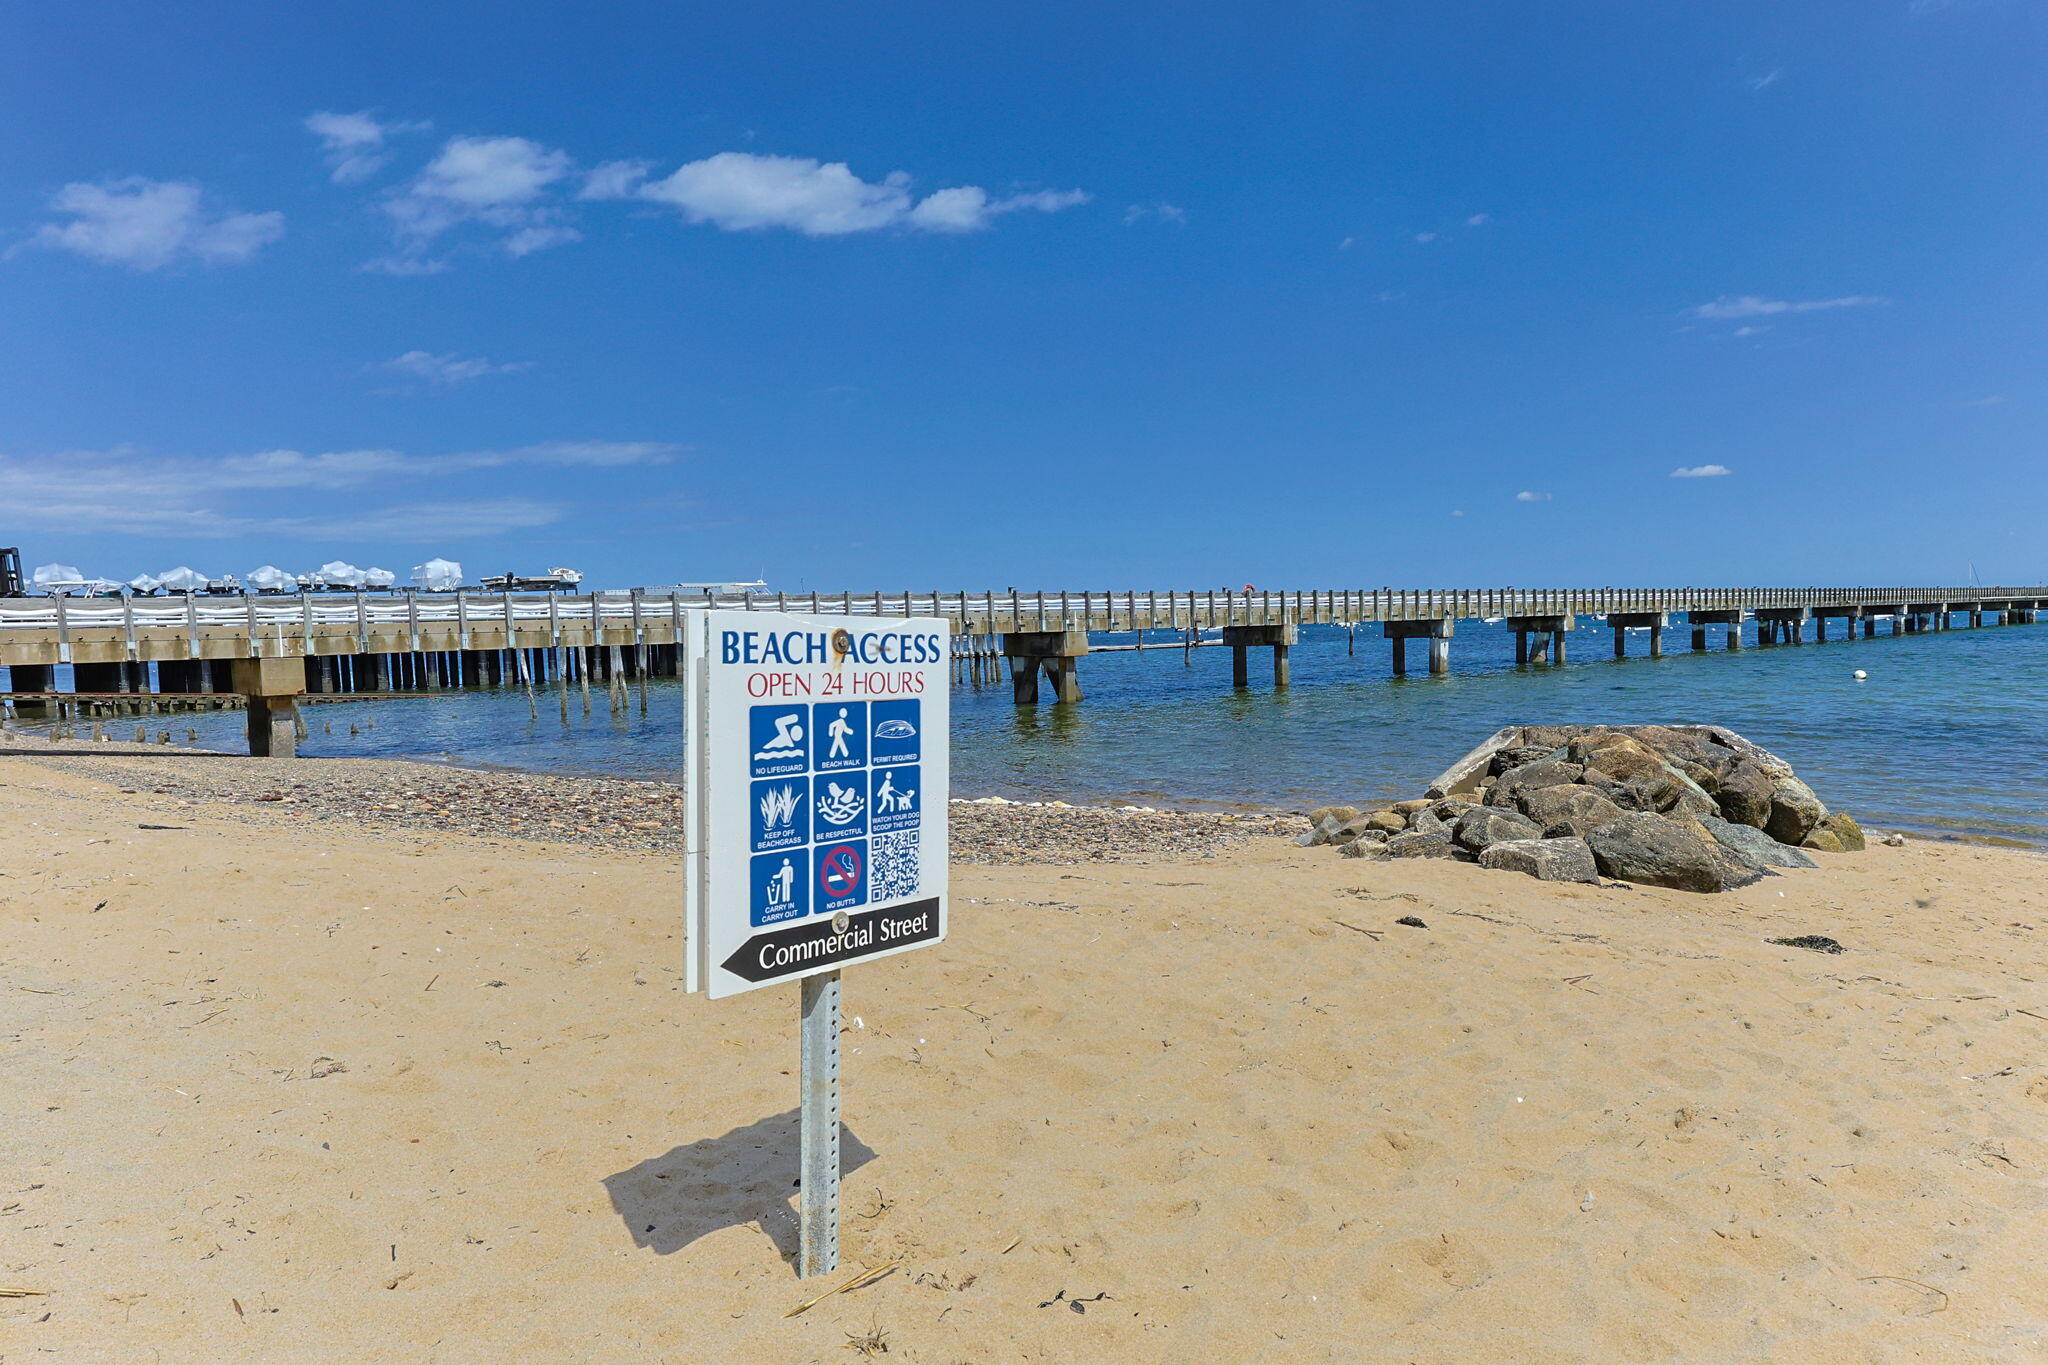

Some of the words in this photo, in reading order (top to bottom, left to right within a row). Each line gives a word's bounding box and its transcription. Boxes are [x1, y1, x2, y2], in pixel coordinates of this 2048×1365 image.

[722, 631, 827, 665] BEACH
[840, 632, 941, 665] ACCESS
[747, 672, 812, 698] OPEN
[822, 672, 843, 696] 24
[853, 671, 924, 694] HOURS
[843, 759, 860, 767] WALK
[892, 754, 917, 762] REQUIRED
[756, 767, 767, 775] NO
[768, 764, 803, 774] LIFEGUARD
[872, 815, 892, 824] WATCH
[892, 813, 907, 821] YOUR
[907, 811, 920, 819] DOG
[872, 823, 892, 832] SCOOP
[904, 819, 920, 827] POOP
[764, 831, 781, 840] KEEP
[782, 829, 796, 837] OFF
[826, 828, 862, 839] RESPECTFUL
[758, 837, 801, 849] BEACHGRASS
[764, 903, 787, 914] CARRY
[787, 902, 795, 910] IN
[826, 902, 836, 910] NO
[836, 897, 856, 909] BUTTS
[761, 911, 784, 923] CARRY
[784, 909, 799, 919] OUT
[758, 919, 873, 970] Commercial
[880, 911, 929, 942] Street
